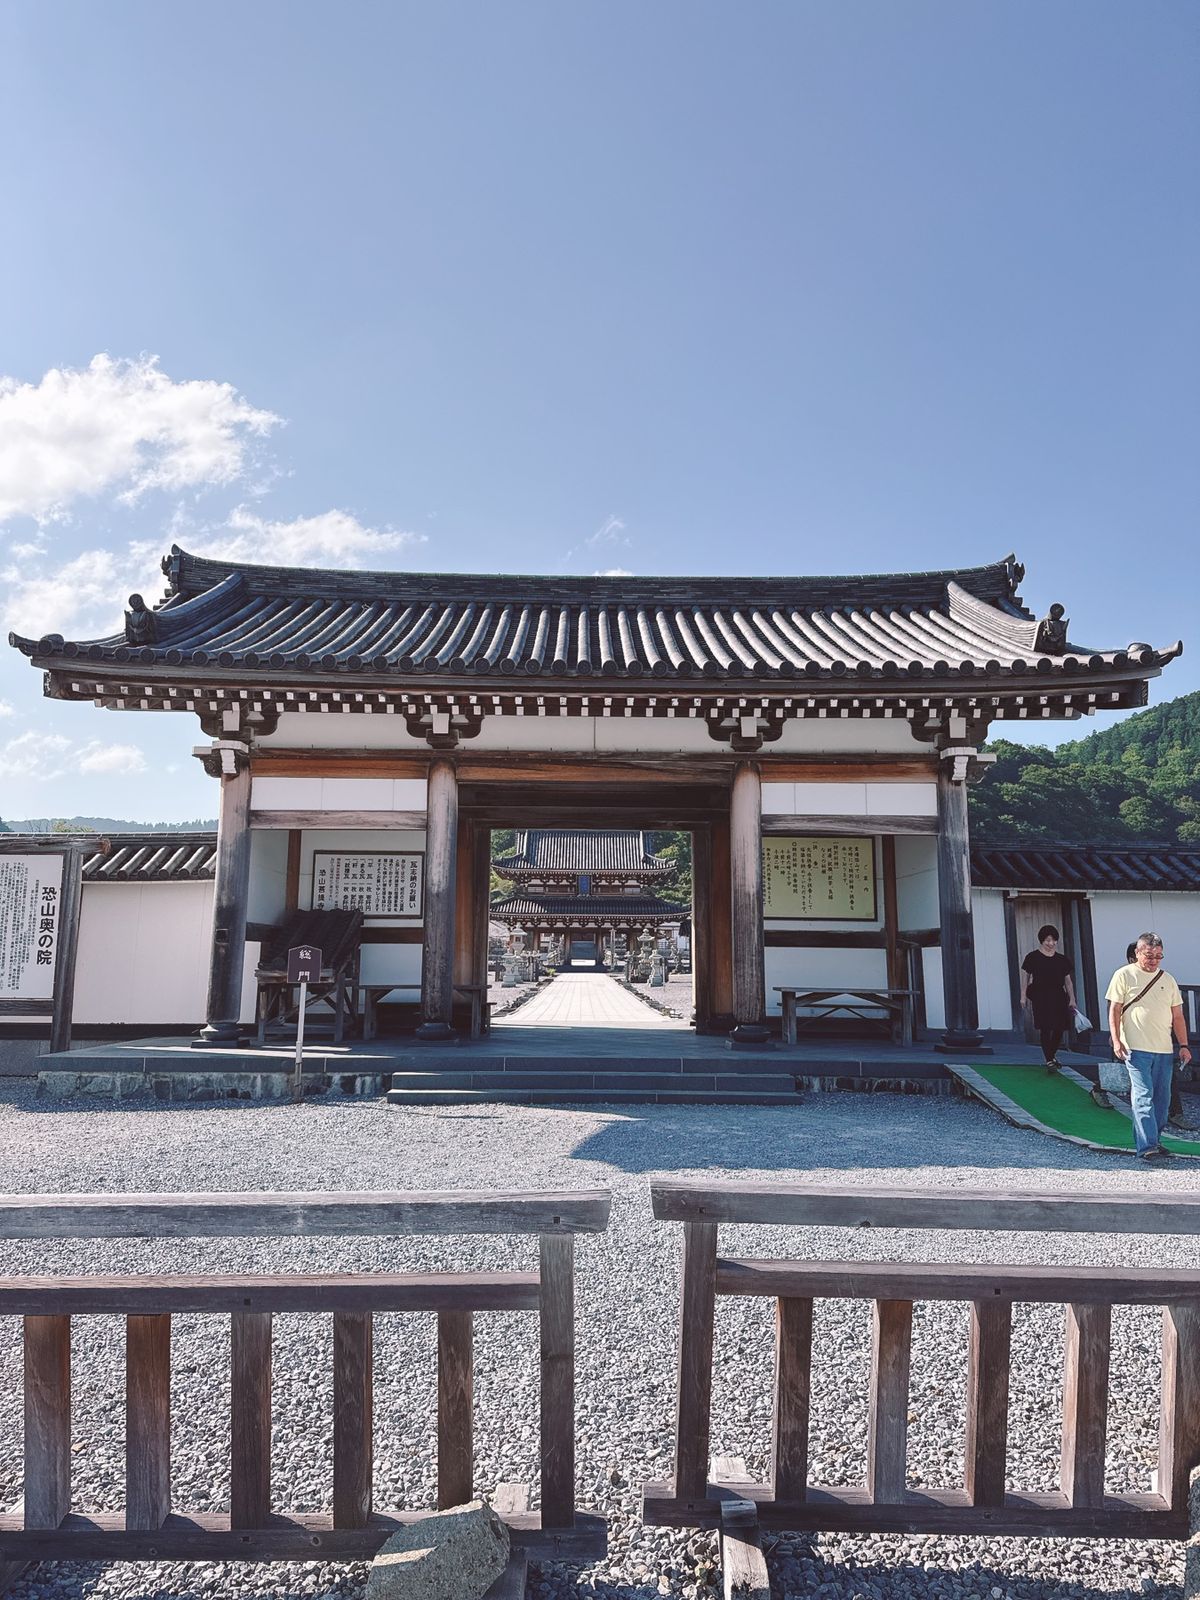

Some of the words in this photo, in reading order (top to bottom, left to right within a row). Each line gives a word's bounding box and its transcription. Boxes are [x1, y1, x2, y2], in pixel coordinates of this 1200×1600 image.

[36, 886, 57, 965] 恐山奥の院
[297, 949, 312, 981] 総門
